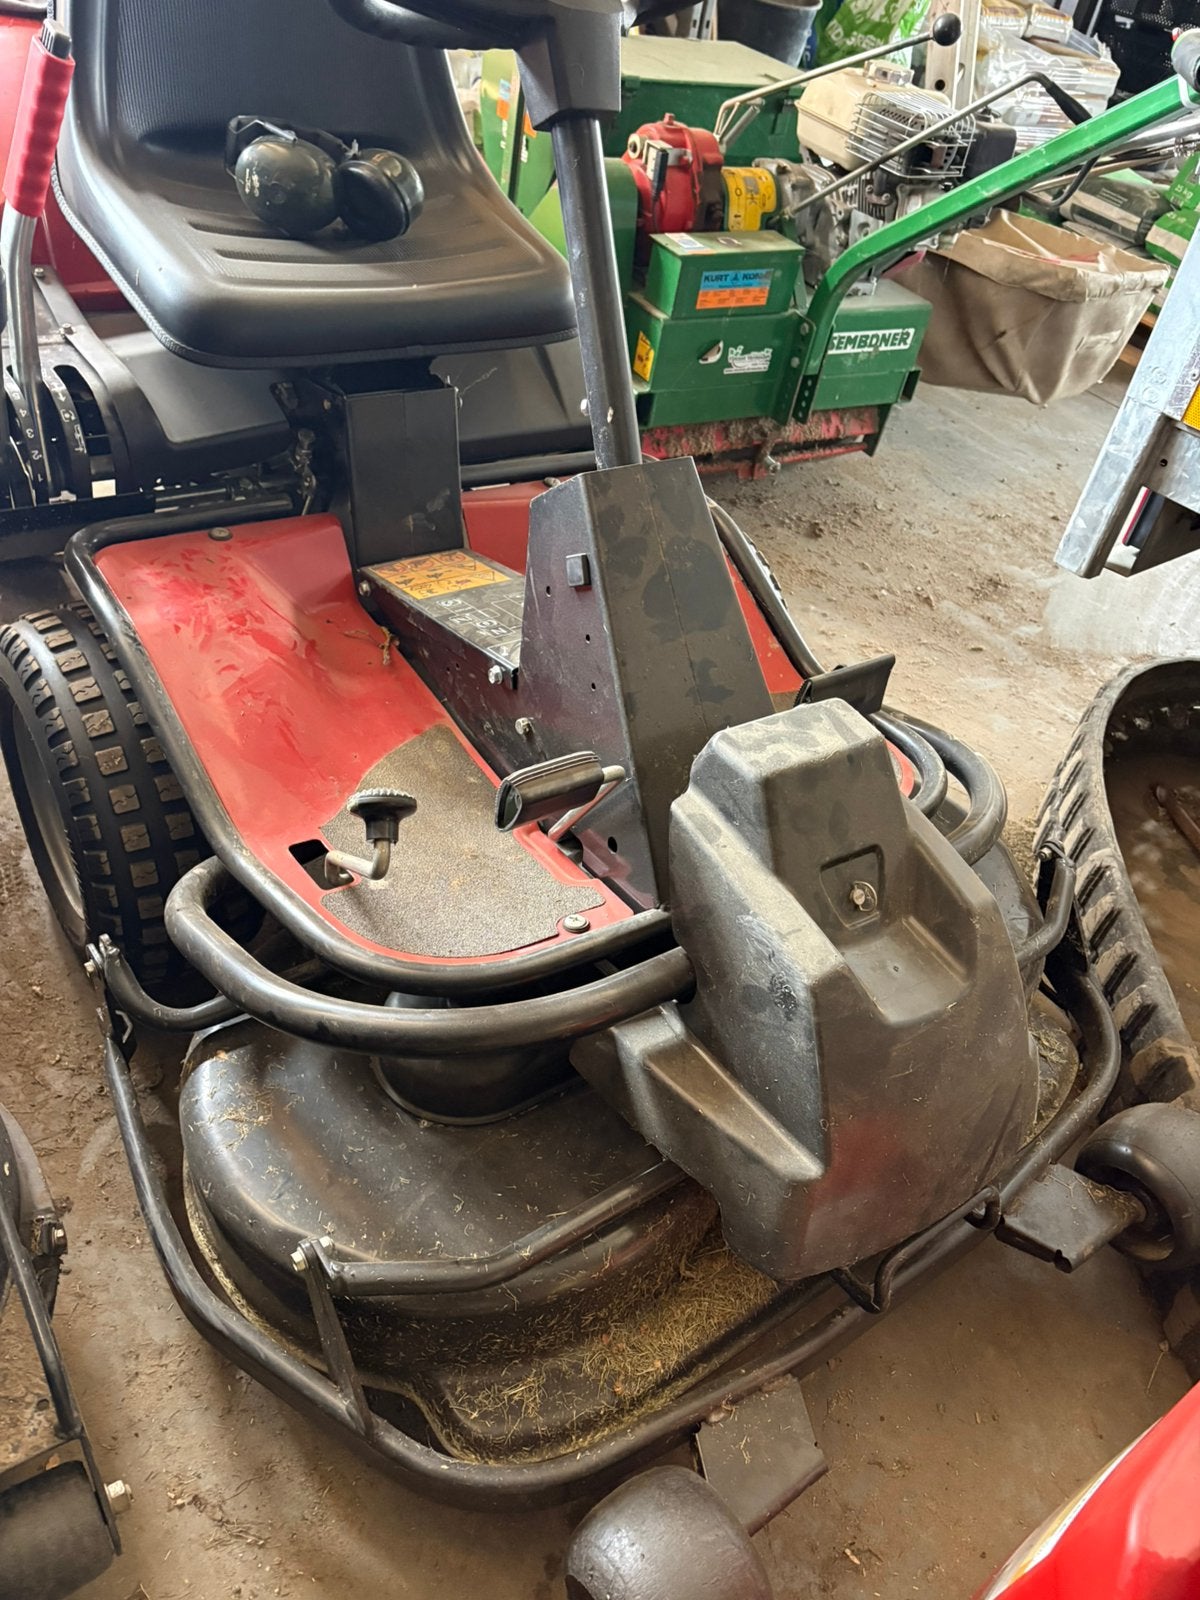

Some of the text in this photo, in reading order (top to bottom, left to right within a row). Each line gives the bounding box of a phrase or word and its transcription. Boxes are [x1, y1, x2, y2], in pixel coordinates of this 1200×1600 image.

[703, 274, 730, 284] KURT
[19, 408, 27, 417] 4
[26, 428, 34, 438] 3
[31, 450, 41, 459] 2
[38, 473, 43, 481] 1
